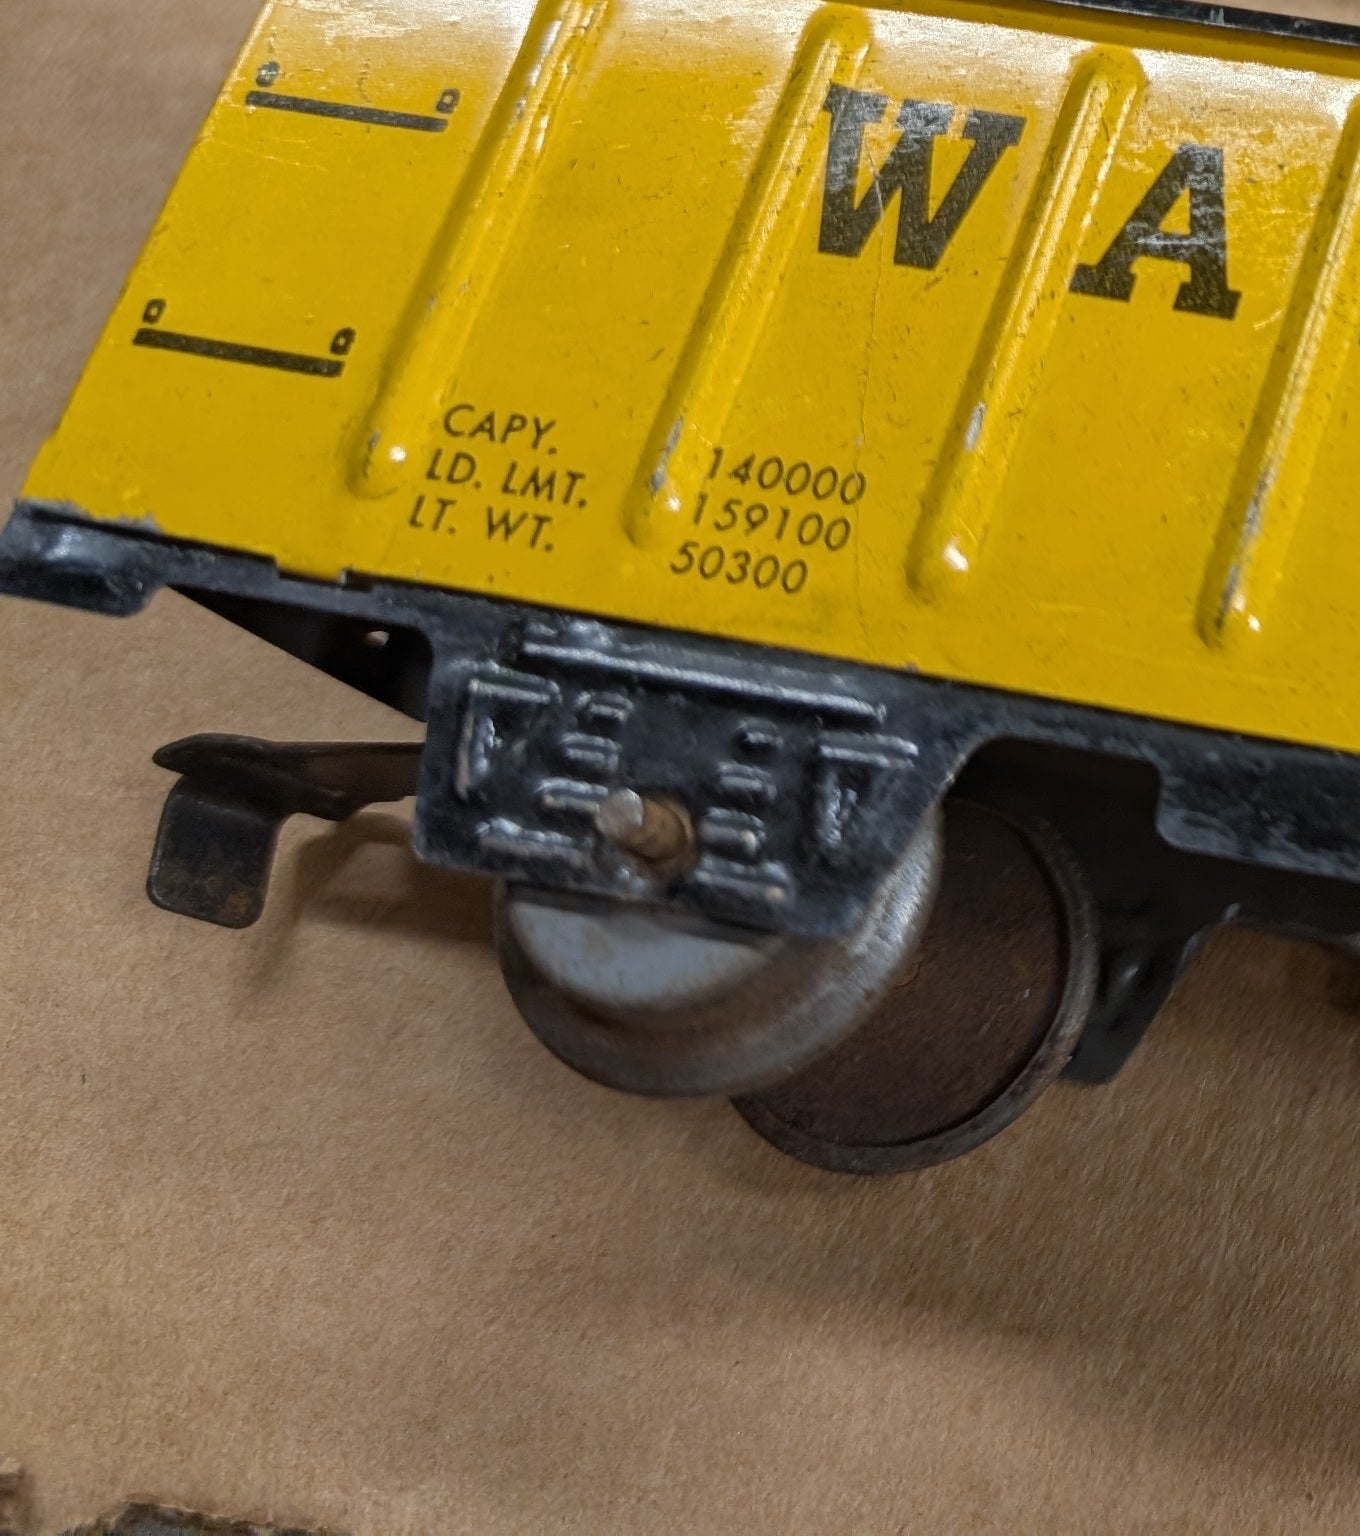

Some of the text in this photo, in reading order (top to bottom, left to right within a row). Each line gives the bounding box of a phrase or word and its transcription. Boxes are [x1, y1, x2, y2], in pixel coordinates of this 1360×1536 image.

[443, 404, 557, 455] CAPY.
[426, 448, 588, 509] LD. LMT.
[704, 447, 867, 505] 140000
[408, 494, 555, 553] LT. WT.
[691, 493, 851, 552] 159100
[669, 541, 808, 594] 50300
